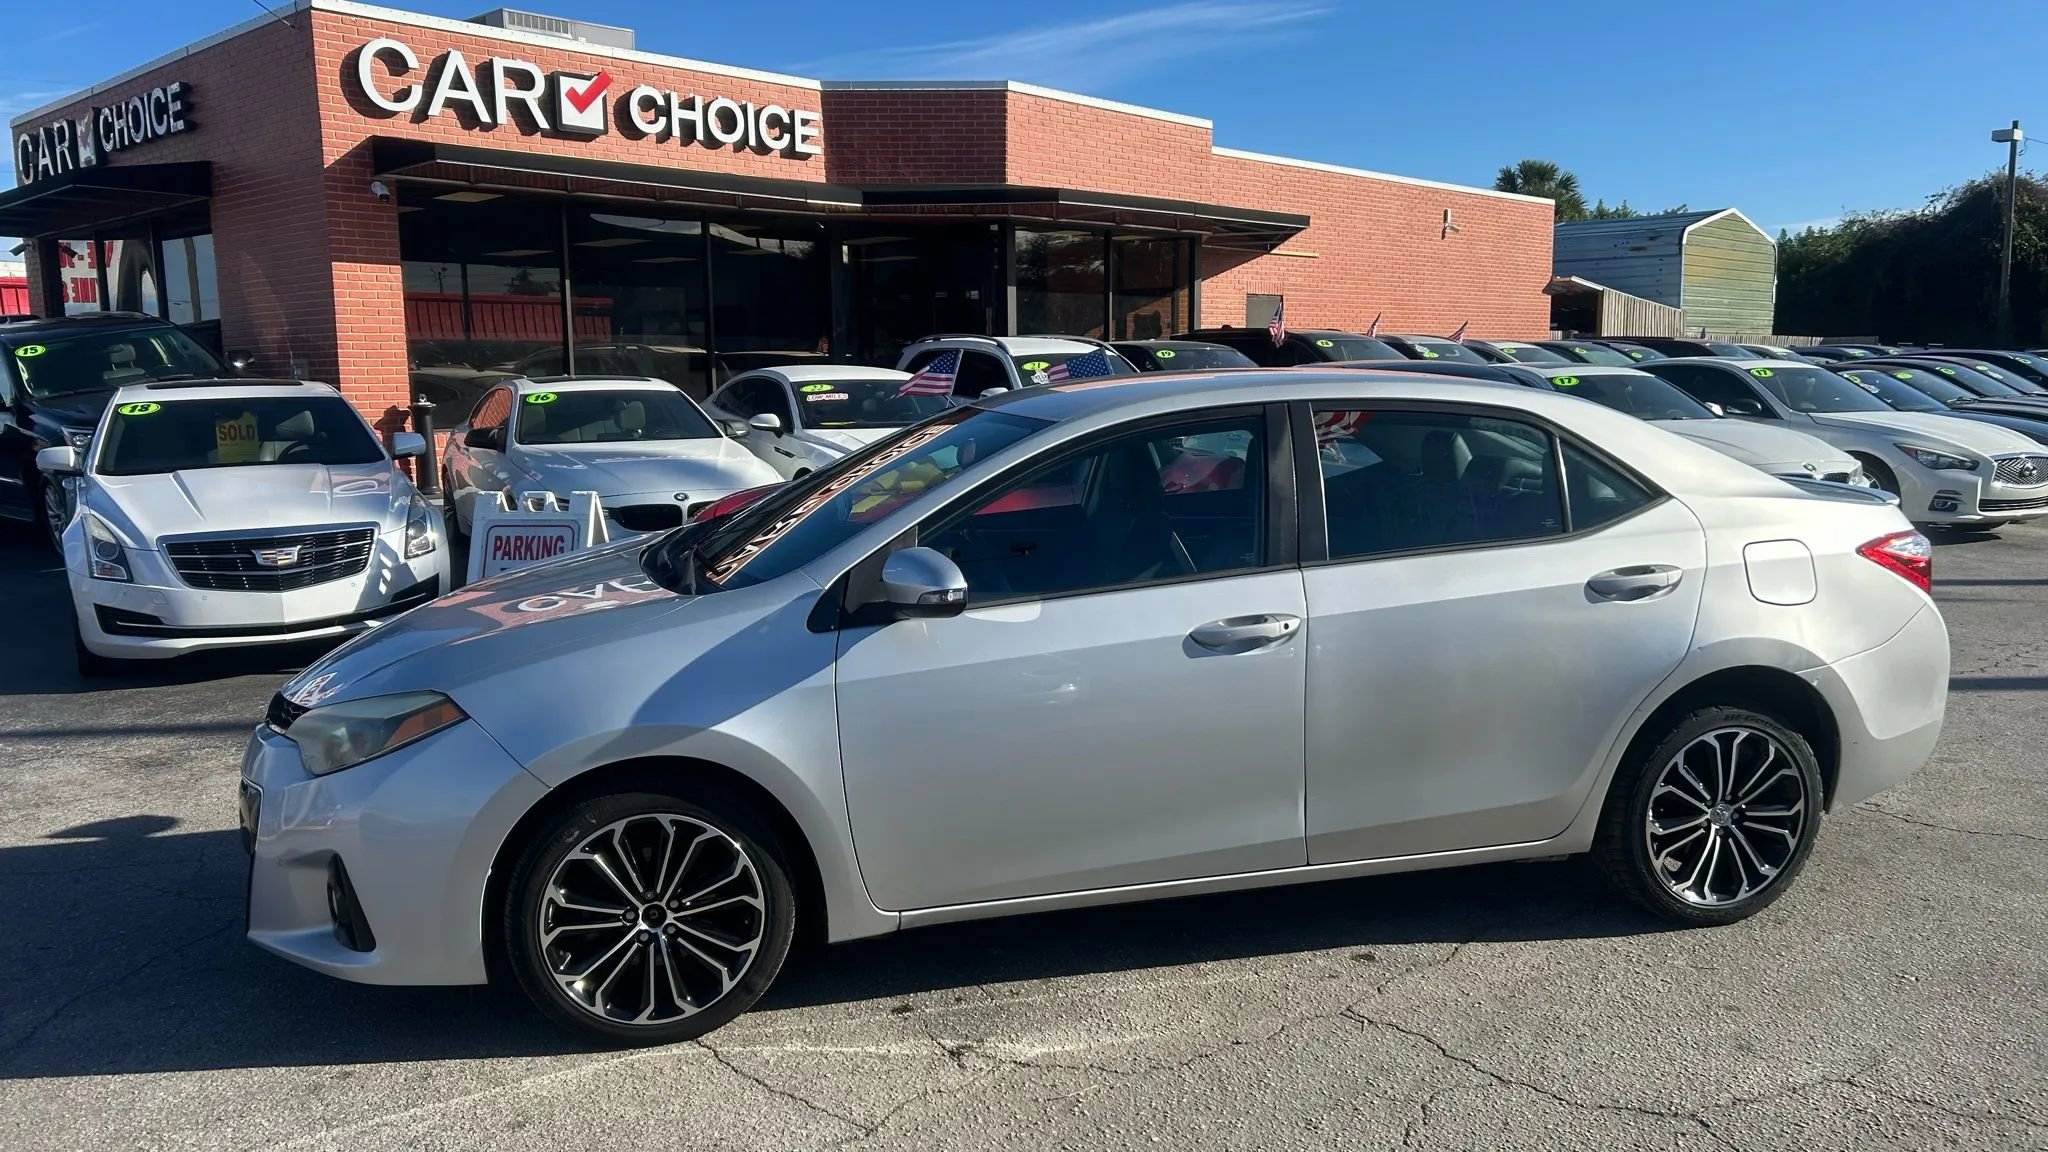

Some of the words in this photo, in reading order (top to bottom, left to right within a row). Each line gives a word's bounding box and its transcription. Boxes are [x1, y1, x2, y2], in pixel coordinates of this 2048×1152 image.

[358, 37, 549, 129] CAR
[629, 83, 822, 155] CHOICE
[18, 118, 73, 185] CAR
[99, 81, 185, 152] CHOICE
[22, 346, 39, 355] 15
[1557, 377, 1572, 385] 17
[533, 394, 551, 402] 16
[128, 403, 151, 413] 18
[218, 423, 256, 442] SOLD
[492, 535, 565, 561] PARKING
